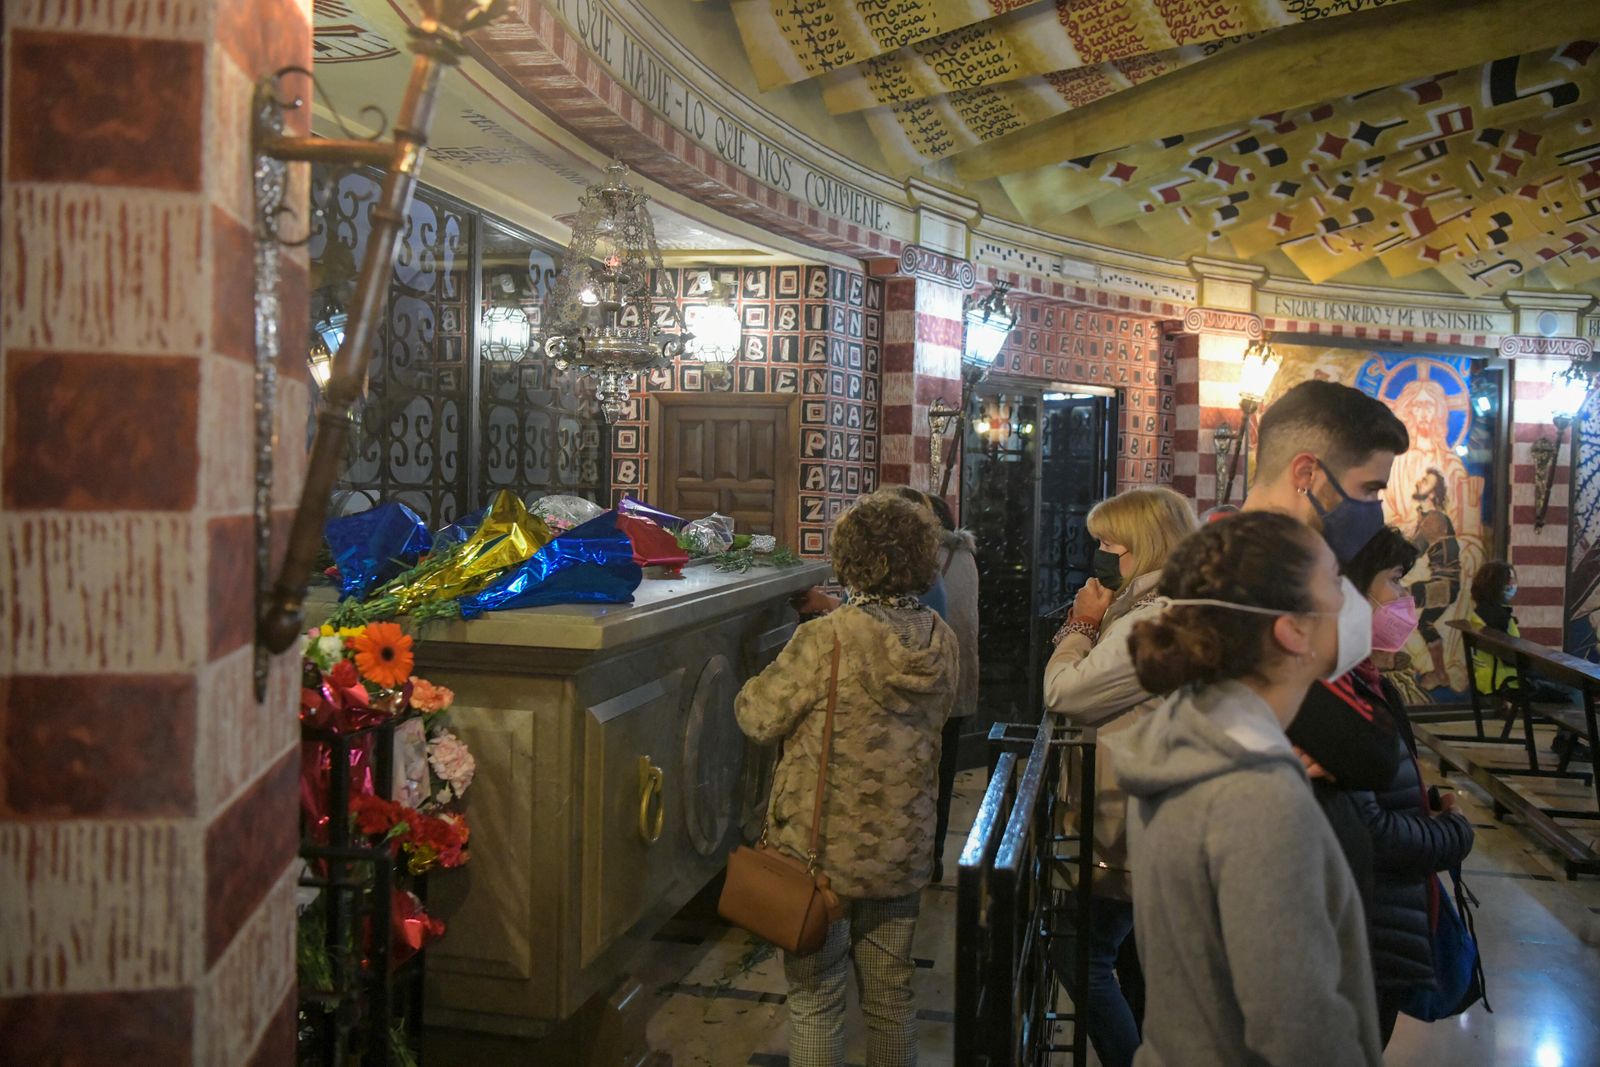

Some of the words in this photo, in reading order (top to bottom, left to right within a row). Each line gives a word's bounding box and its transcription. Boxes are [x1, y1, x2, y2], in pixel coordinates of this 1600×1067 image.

[622, 33, 672, 117] NADIE
[715, 116, 747, 168] QUE
[757, 142, 792, 192] NOS
[1274, 296, 1320, 318] ESTUVE
[1324, 302, 1382, 325] DESNUDO
[1422, 311, 1494, 332] VESTISTEIS
